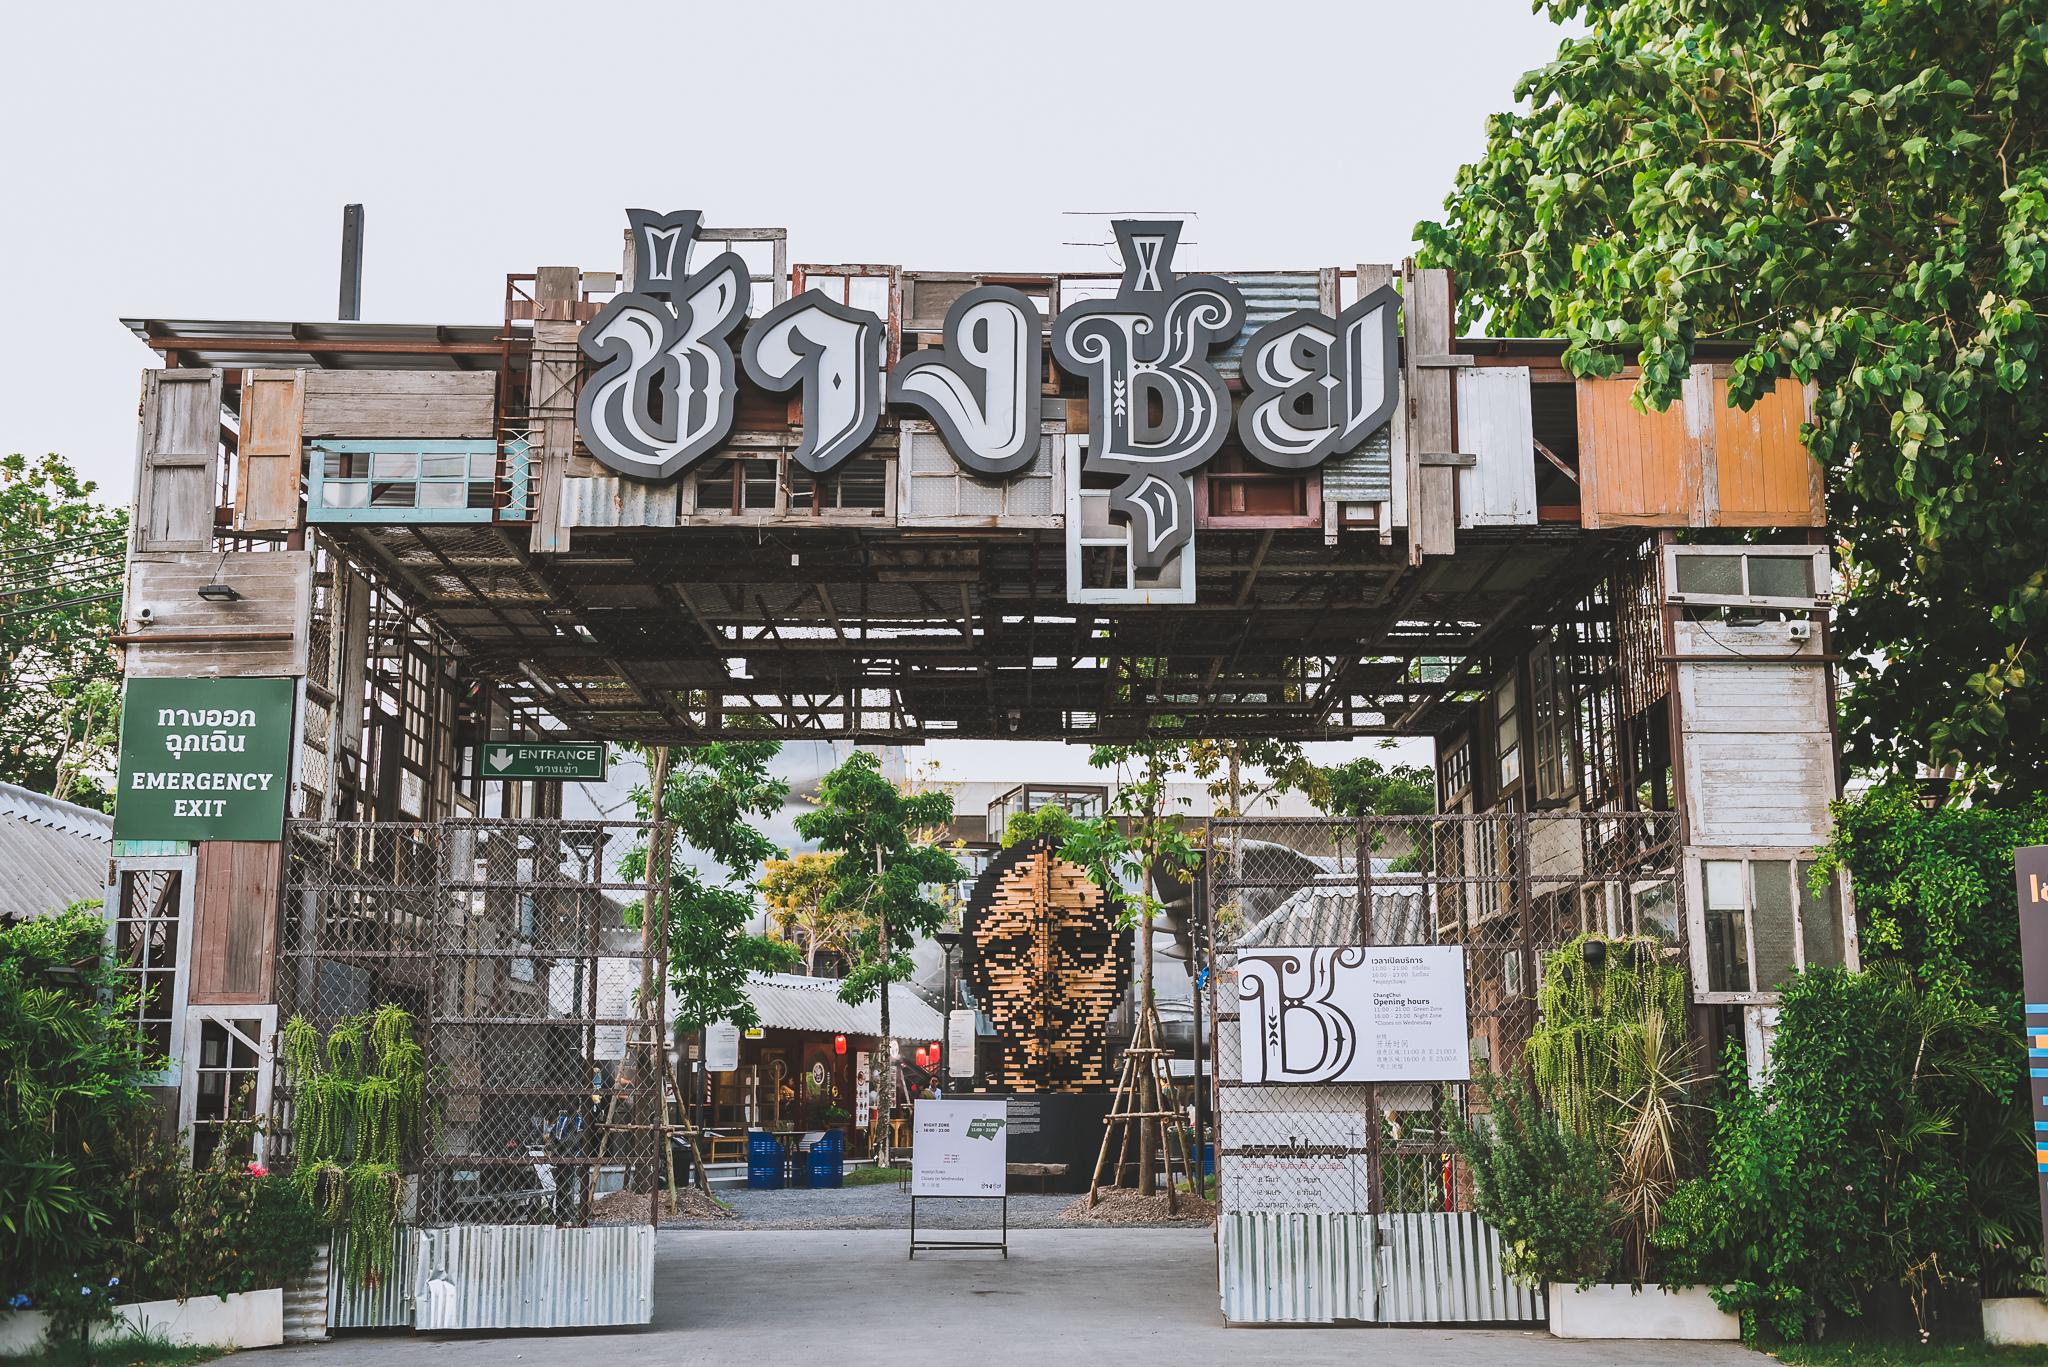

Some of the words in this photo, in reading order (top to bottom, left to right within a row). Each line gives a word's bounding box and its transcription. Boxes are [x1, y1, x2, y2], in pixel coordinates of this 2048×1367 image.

[157, 708, 257, 727] ทางออก
[166, 730, 246, 760] ฉุกเฉิน
[518, 749, 596, 761] ENTRANCE
[534, 762, 578, 774] ทางเข้า
[131, 772, 273, 791] EMERGENCY
[173, 799, 227, 817] EXIT
[1373, 998, 1406, 1006] Opening
